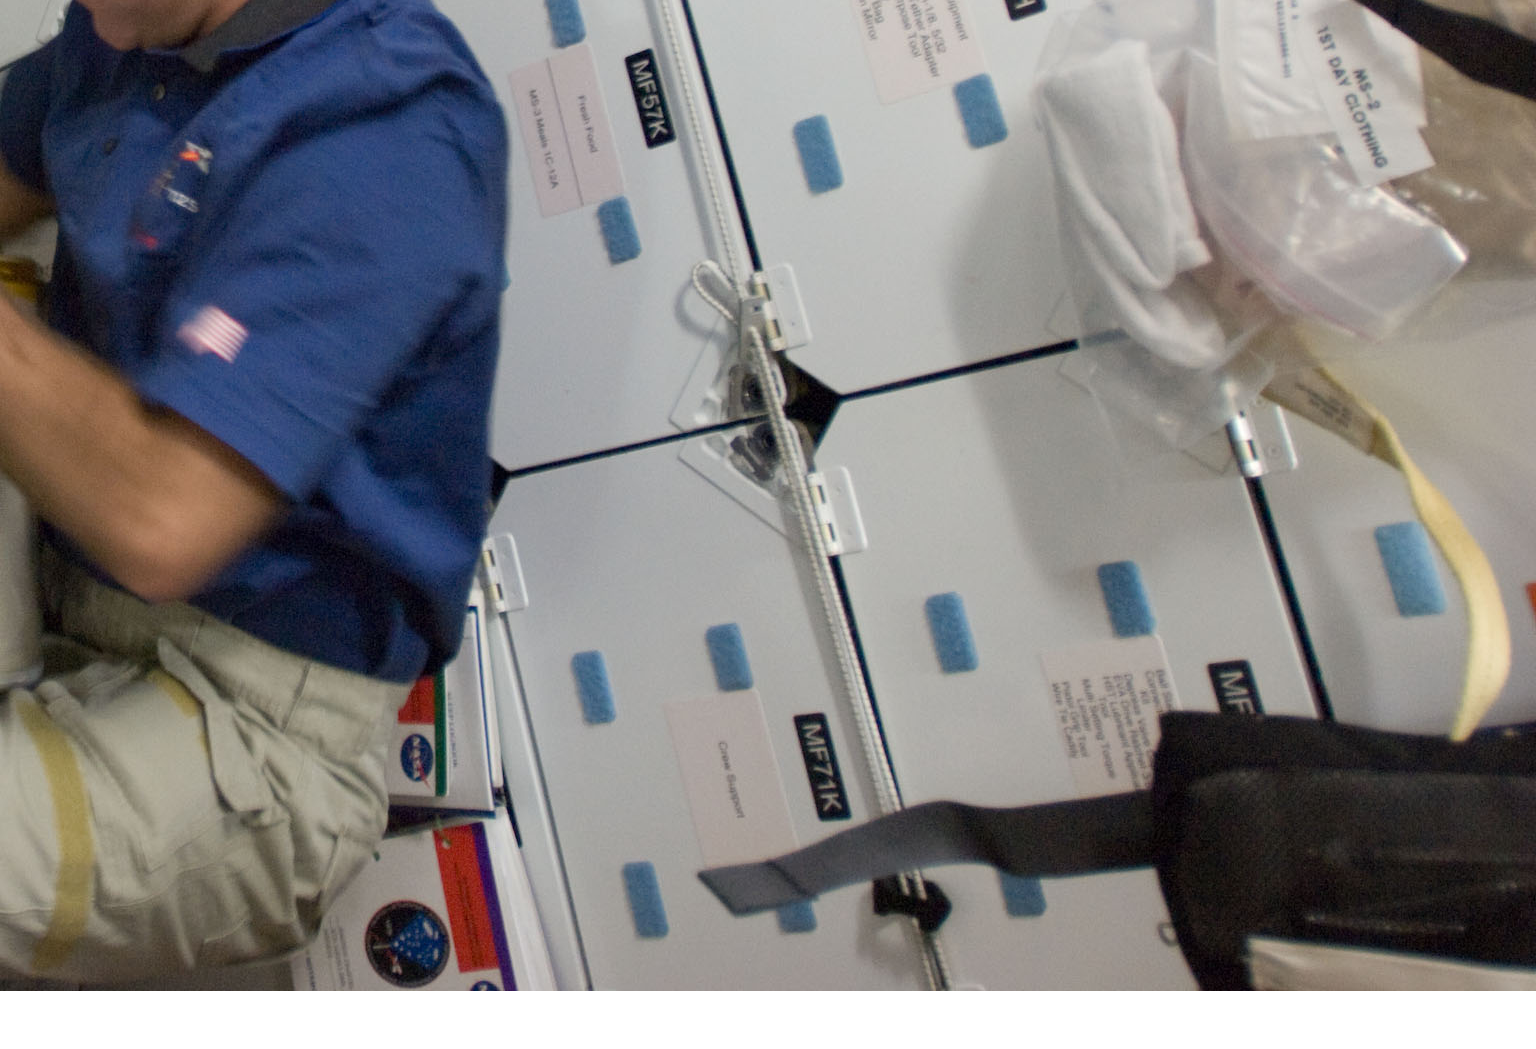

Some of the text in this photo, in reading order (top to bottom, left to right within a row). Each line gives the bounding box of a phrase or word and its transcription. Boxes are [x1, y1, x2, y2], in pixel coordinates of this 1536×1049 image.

[861, 7, 877, 40] Mirror
[870, 0, 884, 24] Bag
[906, 32, 922, 58] Tool
[919, 34, 939, 77] Adapter
[632, 59, 667, 138] MF57K
[1316, 24, 1388, 168] 1ST DAY CLOTHING
[1352, 67, 1380, 110] MS-2
[528, 88, 542, 117] MS-3
[535, 117, 548, 149] Meals
[576, 94, 599, 153] Fresh Food
[1112, 674, 1127, 697] EVA
[1062, 725, 1078, 758] Caddy
[1076, 734, 1089, 757] Tool
[716, 740, 745, 819] Crew Support
[802, 722, 841, 810] MF71K
